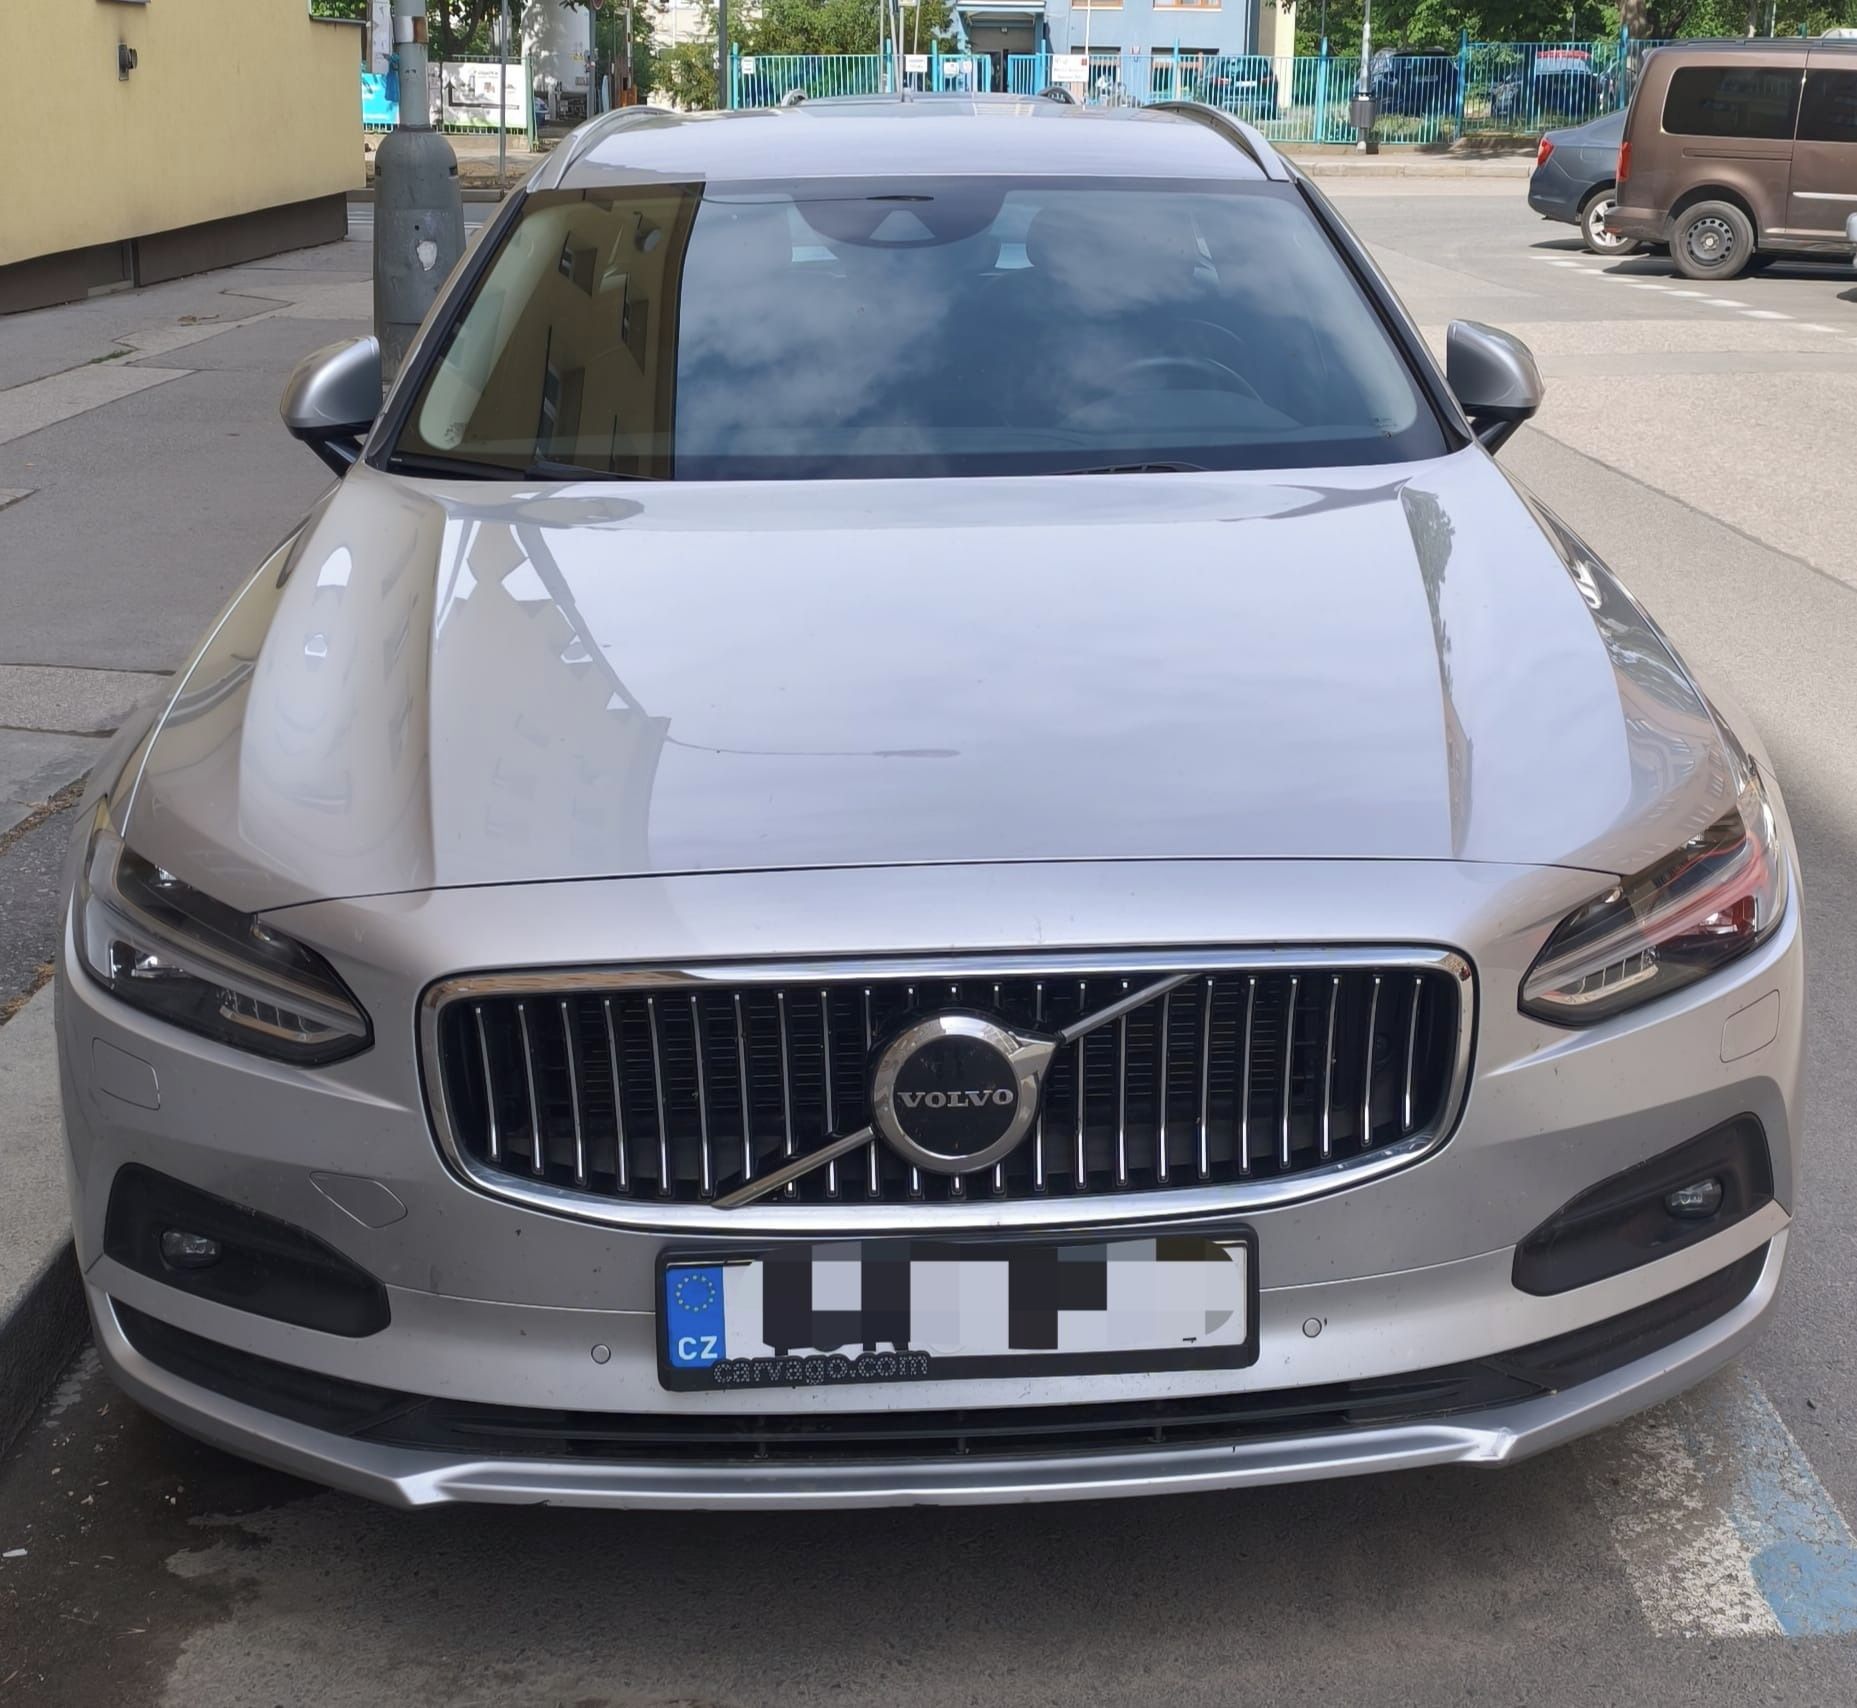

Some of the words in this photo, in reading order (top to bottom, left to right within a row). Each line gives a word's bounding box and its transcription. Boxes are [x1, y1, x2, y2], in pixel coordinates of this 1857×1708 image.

[897, 1088, 1014, 1109] VOLVO
[678, 1336, 718, 1360] CZ
[713, 1353, 928, 1385] carvago.com
